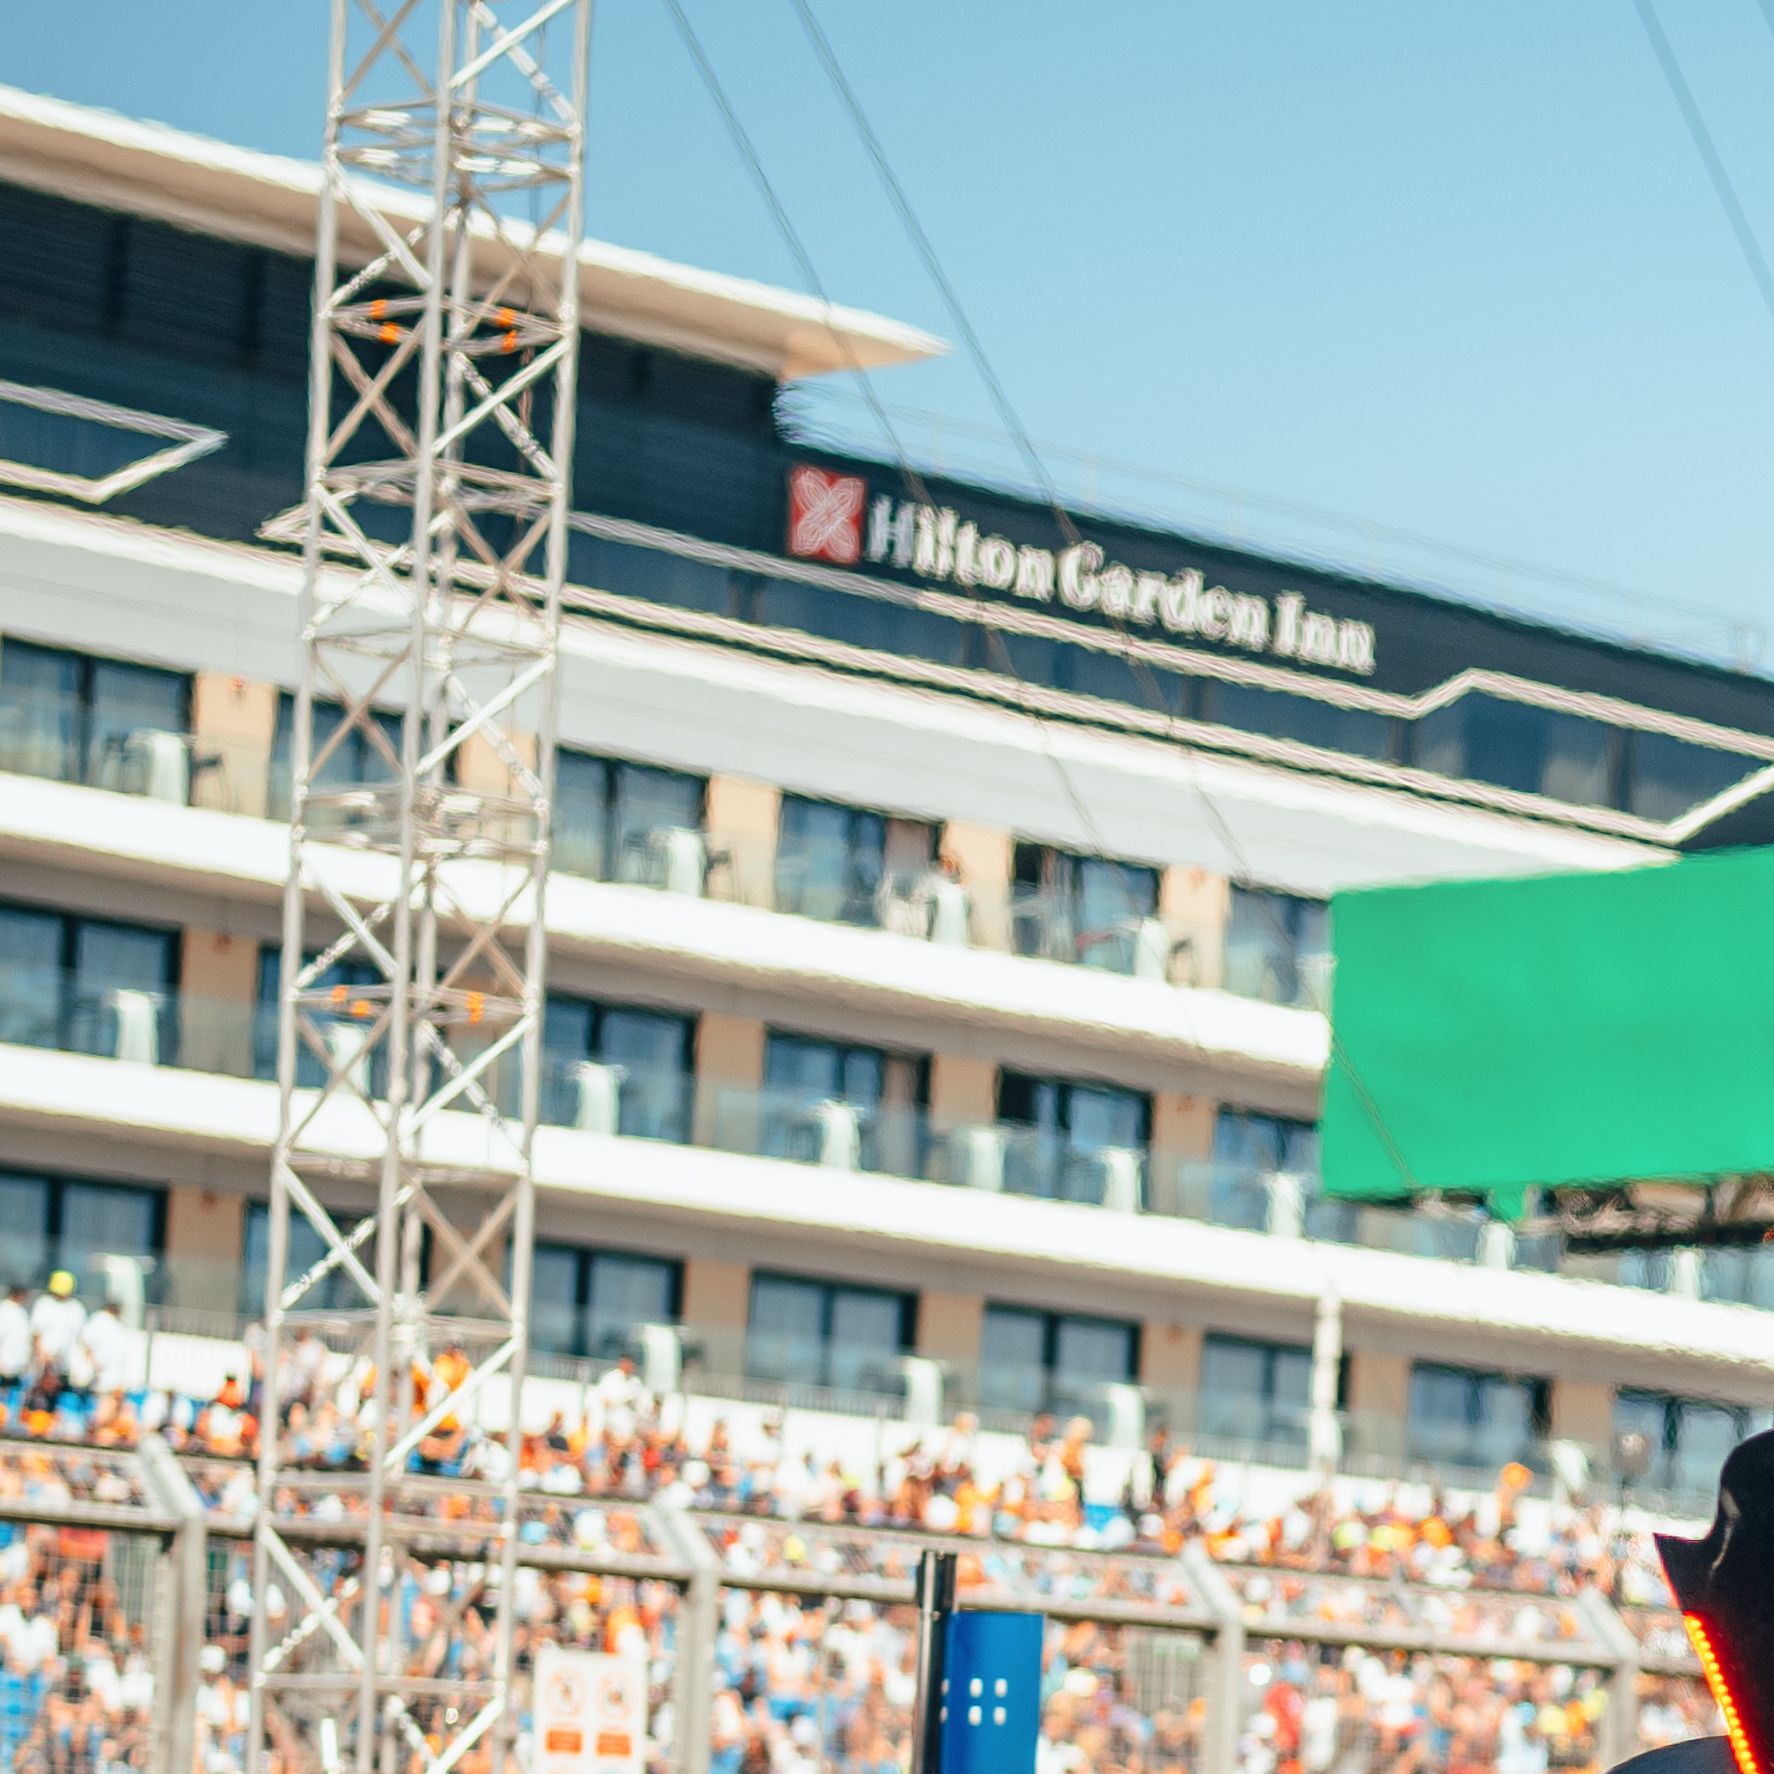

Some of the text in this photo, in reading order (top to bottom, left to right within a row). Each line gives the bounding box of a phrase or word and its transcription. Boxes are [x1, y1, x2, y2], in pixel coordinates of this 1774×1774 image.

[867, 495, 1377, 677] Hilton Garden Inn
